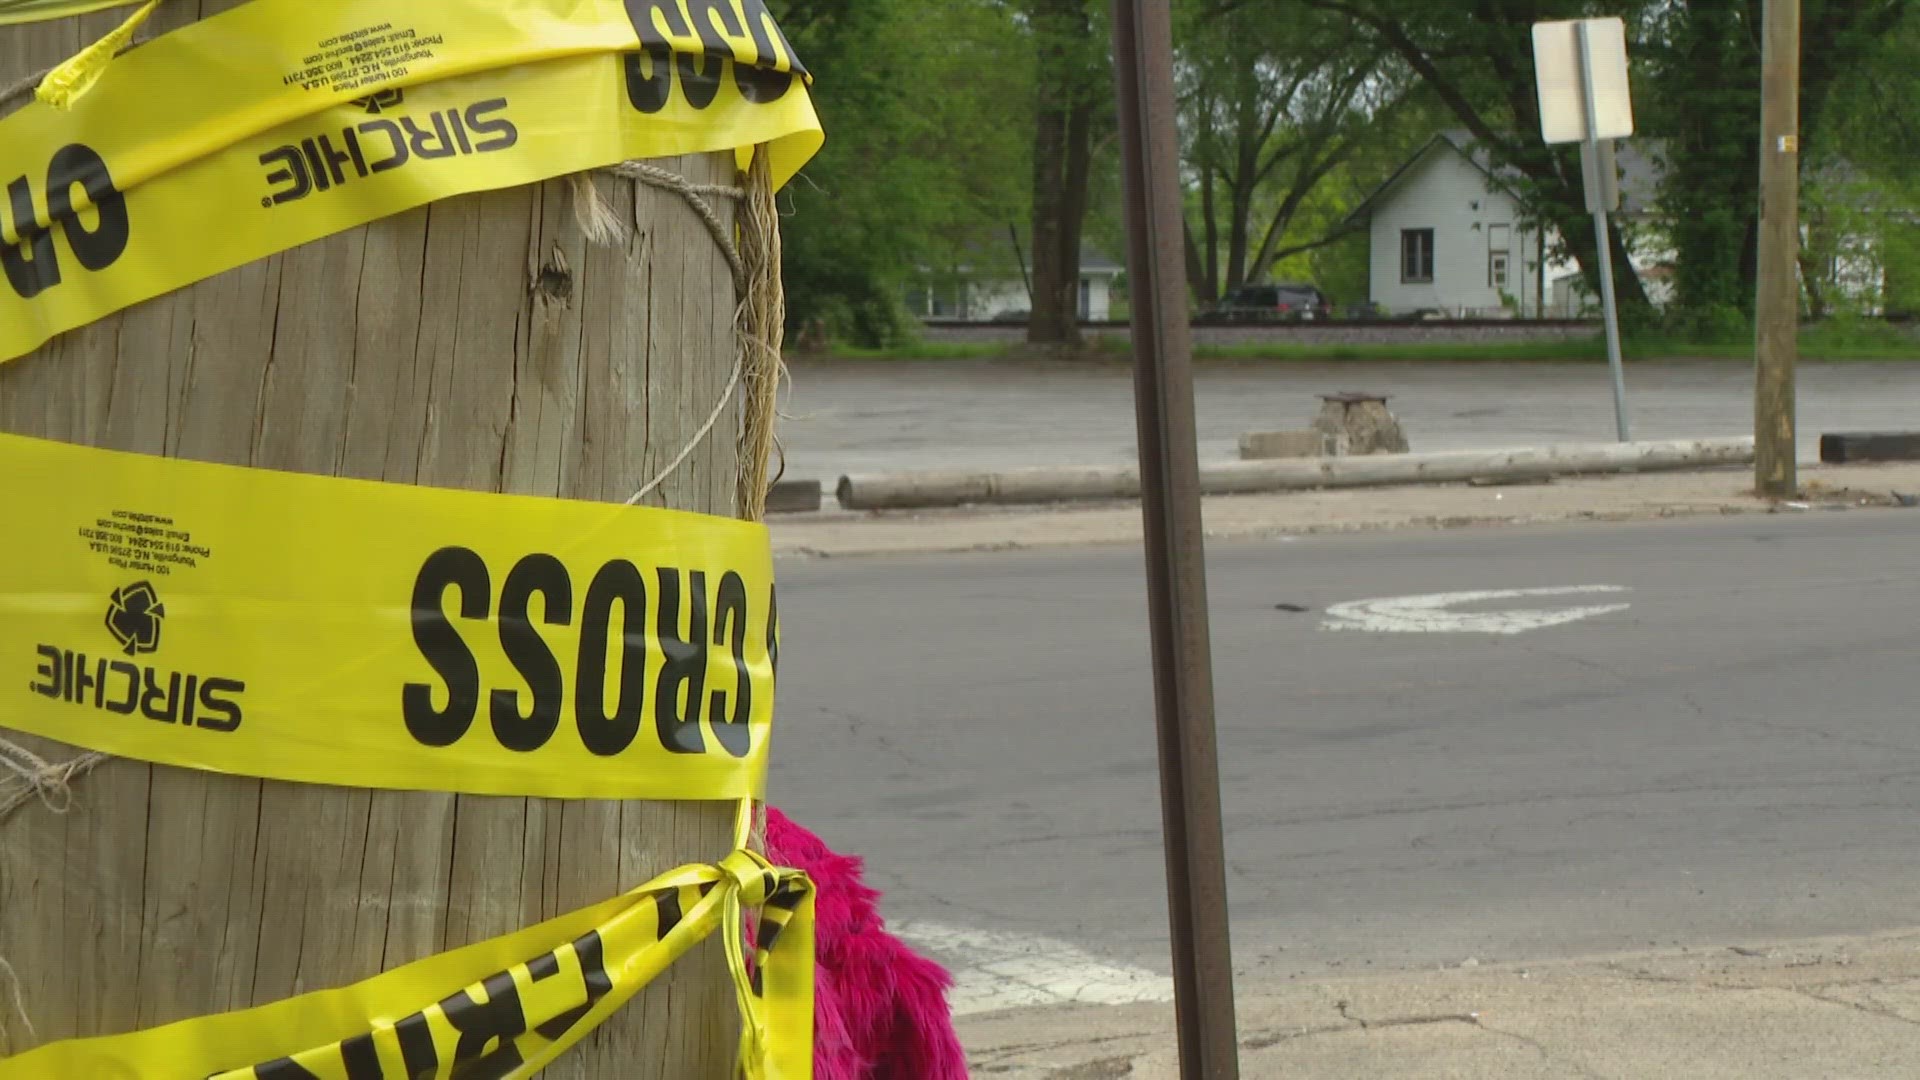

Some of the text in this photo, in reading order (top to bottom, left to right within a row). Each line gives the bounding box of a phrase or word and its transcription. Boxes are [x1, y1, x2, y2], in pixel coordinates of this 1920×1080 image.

[318, 23, 391, 50] www.sirchie.com
[387, 28, 415, 43] Email:
[411, 34, 442, 50] Phone:
[332, 66, 408, 93] 100 Hunter Place
[156, 565, 170, 575] 100
[402, 546, 752, 758] CROSS
[36, 643, 246, 732] SIRCHIE
